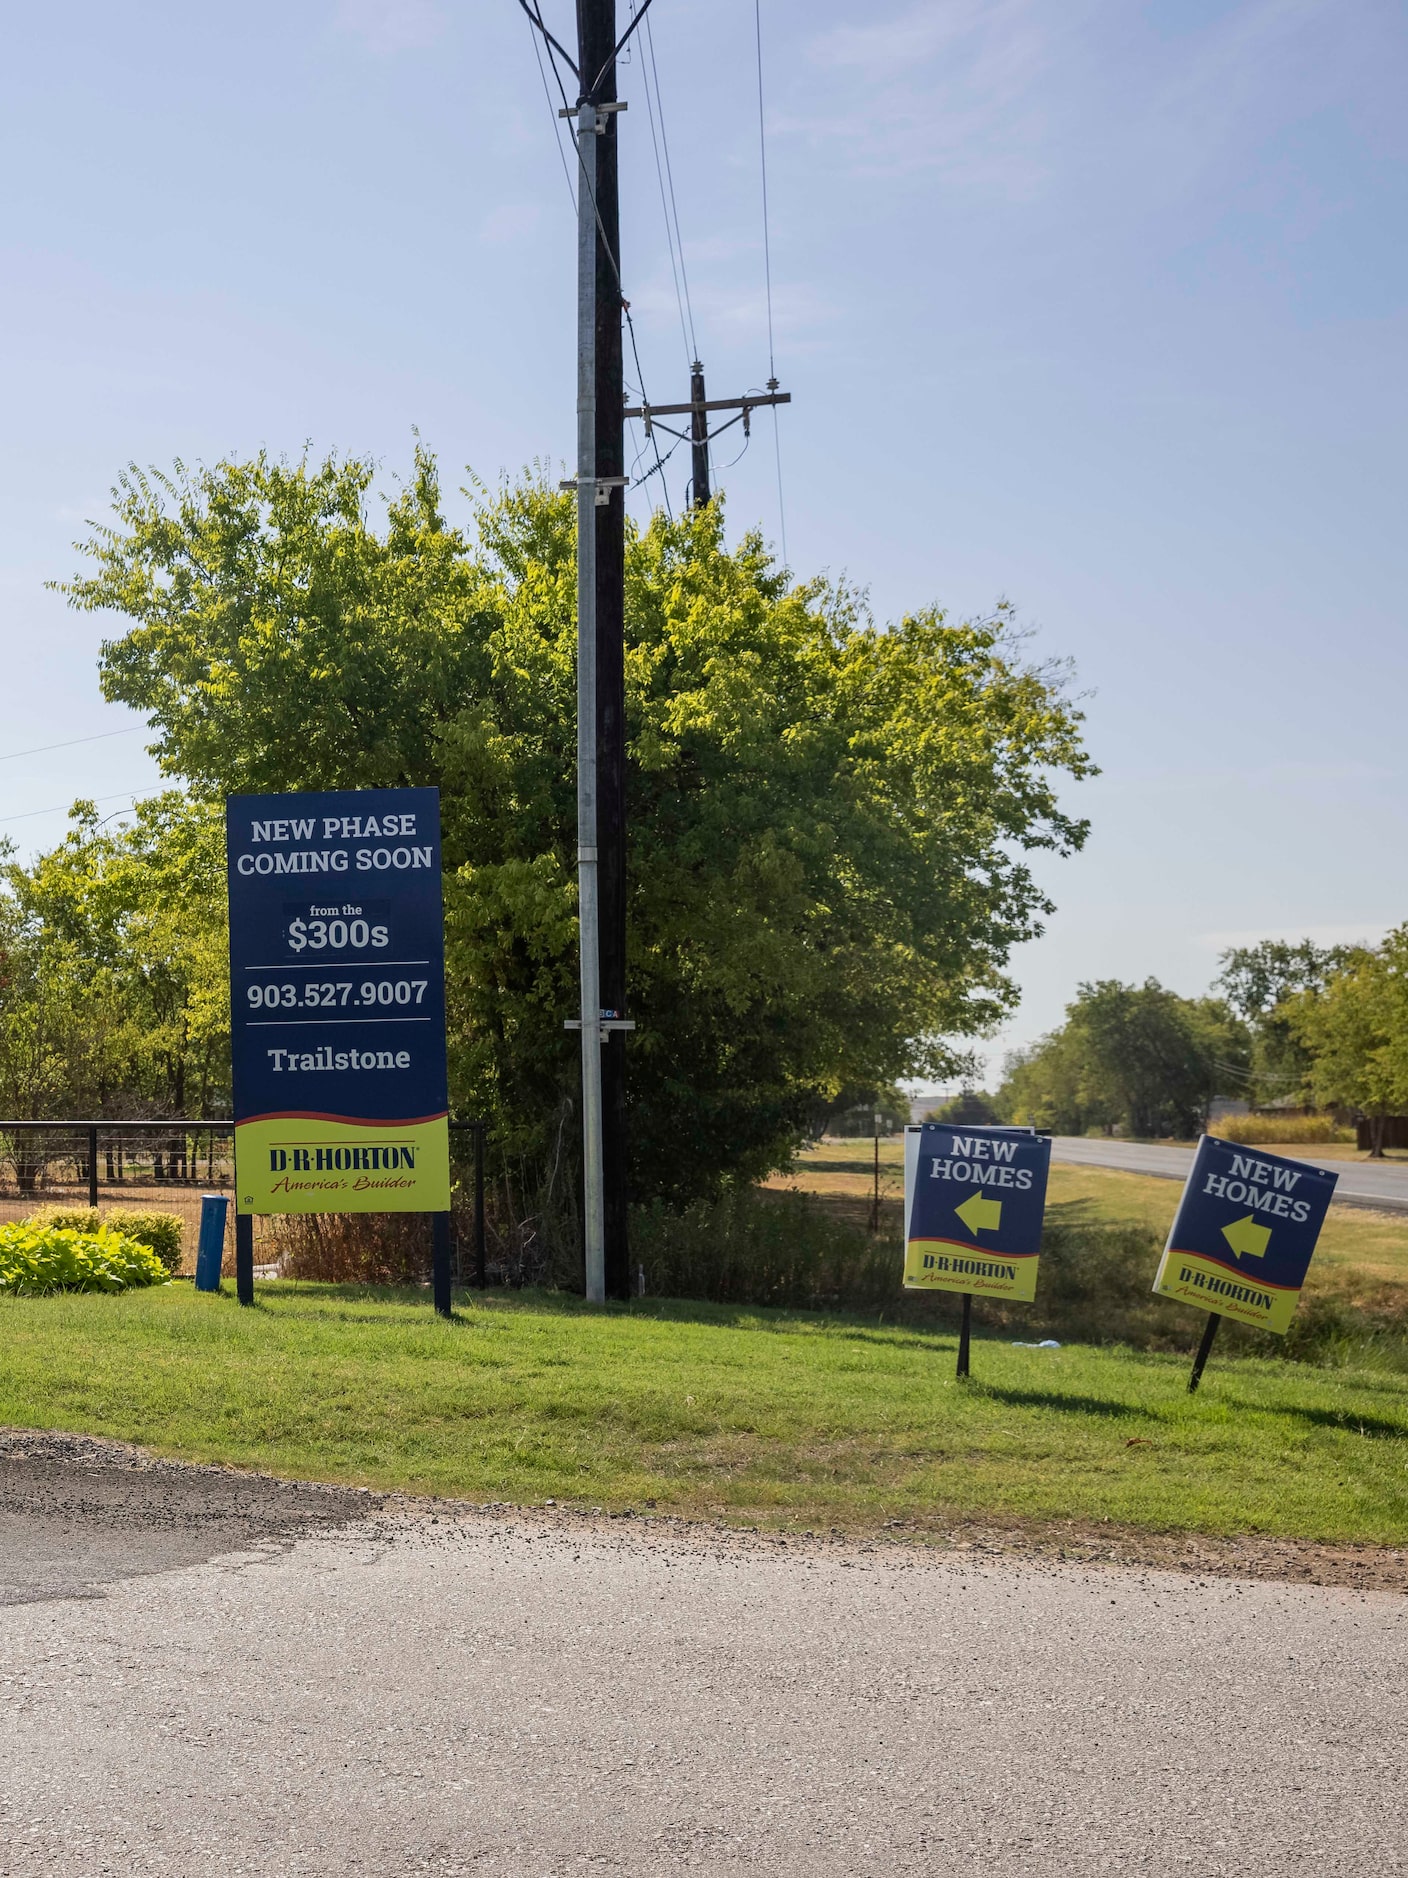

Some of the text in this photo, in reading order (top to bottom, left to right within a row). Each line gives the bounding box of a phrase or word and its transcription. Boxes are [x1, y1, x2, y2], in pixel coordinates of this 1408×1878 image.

[250, 814, 417, 843] NEW PHASE
[237, 846, 433, 876] COMING SOON
[309, 904, 363, 917] from the
[288, 917, 389, 953] $300s
[247, 980, 428, 1009] 903.527.9007
[267, 1046, 411, 1072] Trailstone
[950, 1135, 1019, 1163] NEW
[270, 1175, 417, 1194] America's Builder
[930, 1157, 1033, 1190] HOMES
[1228, 1154, 1302, 1192] NEW
[1202, 1173, 1312, 1223] HOMES
[921, 1271, 1015, 1291] America's Builder
[1226, 1302, 1269, 1320] Builder
